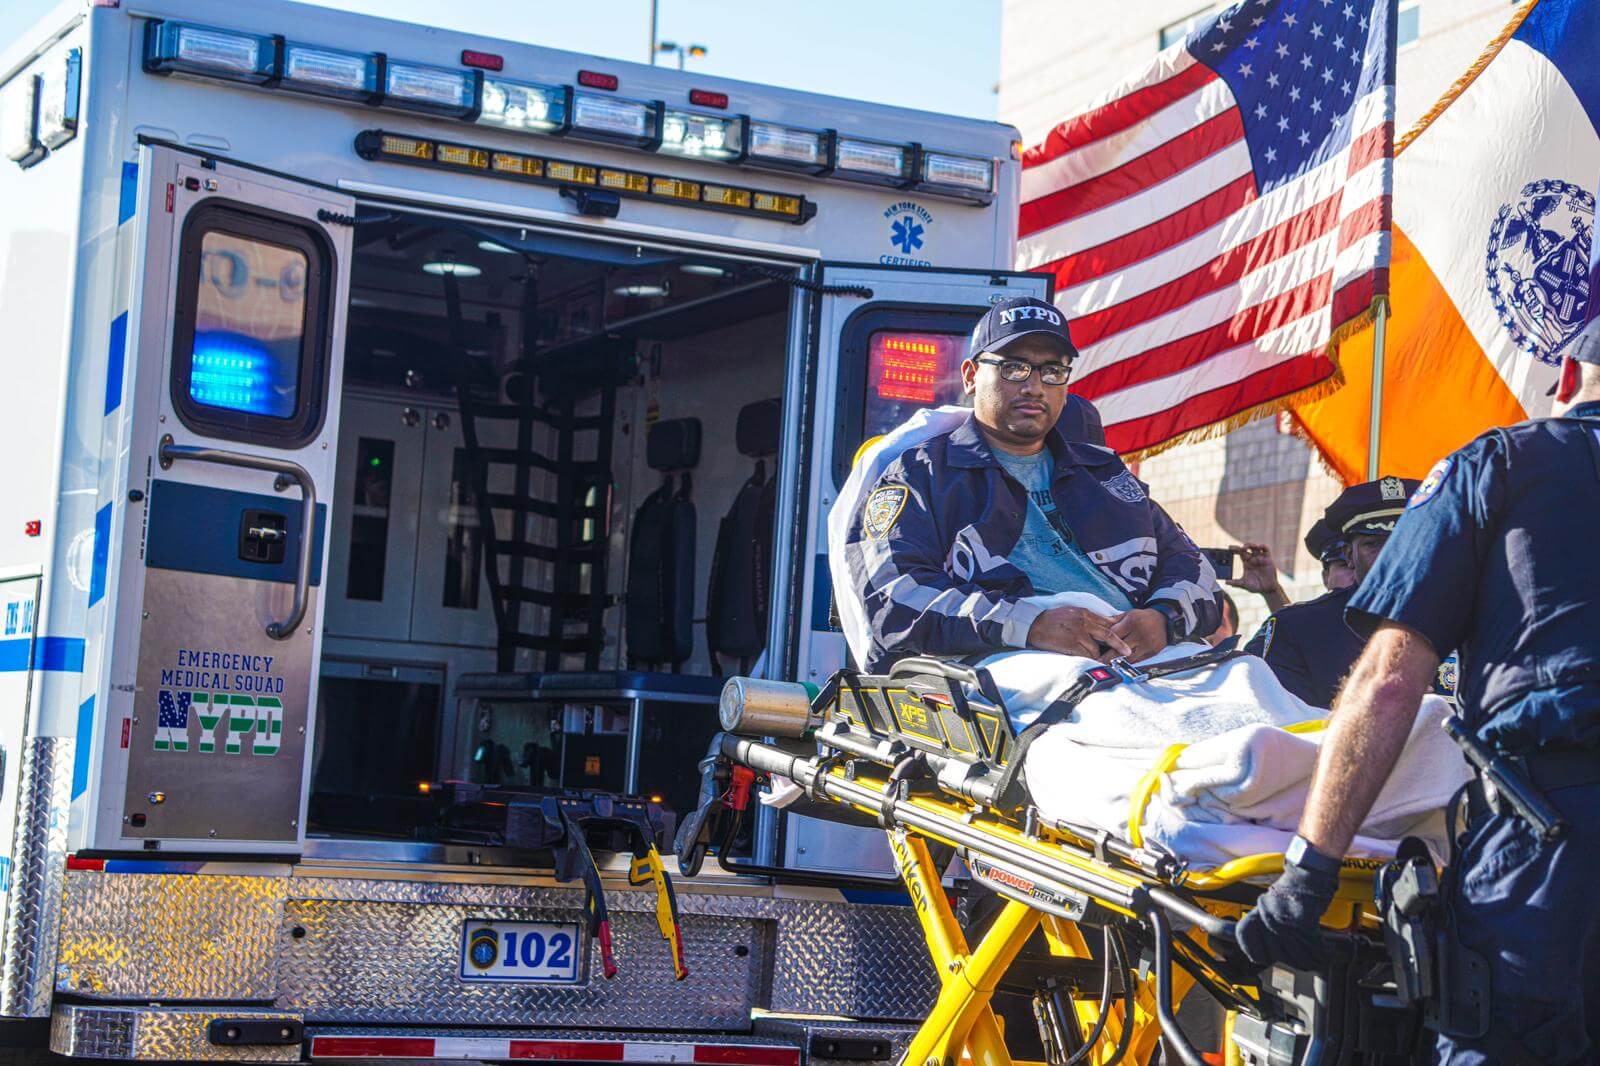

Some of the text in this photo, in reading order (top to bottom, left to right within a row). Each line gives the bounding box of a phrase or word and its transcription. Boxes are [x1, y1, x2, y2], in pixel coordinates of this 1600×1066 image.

[883, 201, 934, 224] NEW YORK STATE
[999, 305, 1061, 326] NYPD
[178, 649, 274, 673] EMERGENCY
[160, 669, 285, 694] MEDICAL SQUAD
[153, 689, 284, 757] NYPD
[899, 702, 928, 724] XPS
[988, 866, 1035, 894] power
[1031, 888, 1054, 906] pro
[502, 931, 572, 968] 102
